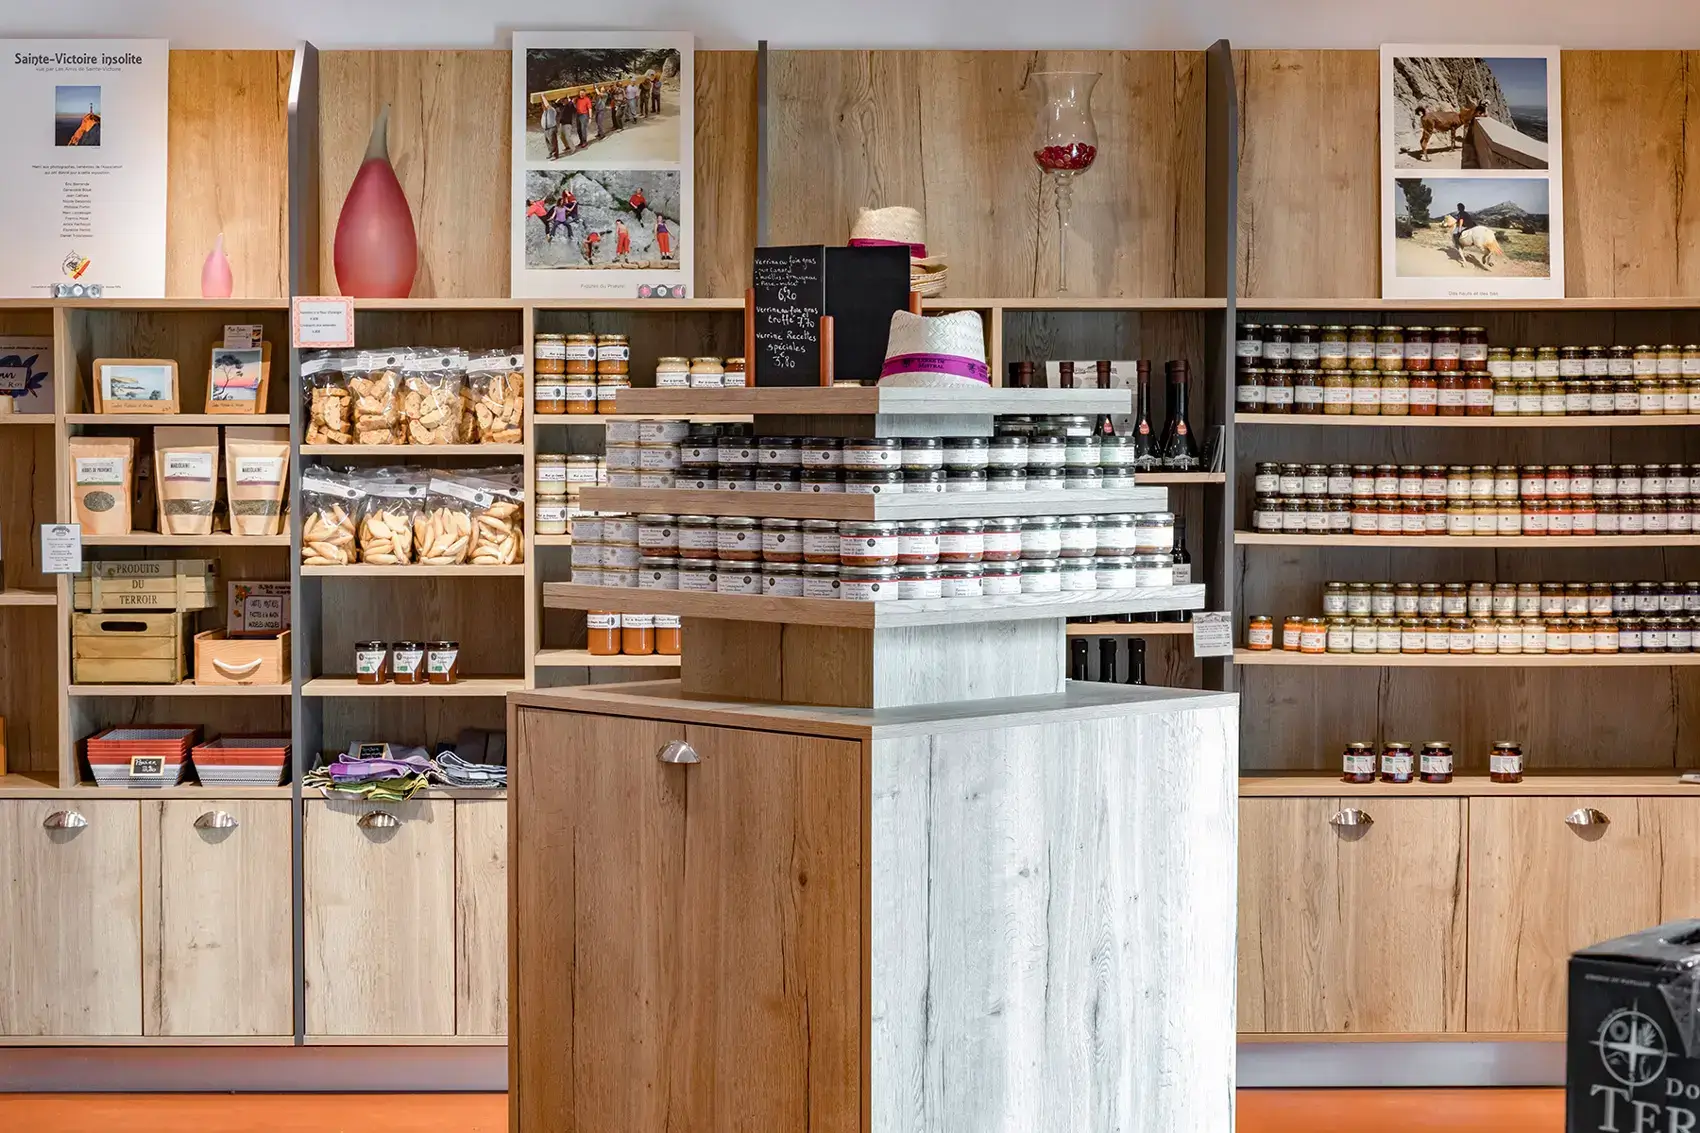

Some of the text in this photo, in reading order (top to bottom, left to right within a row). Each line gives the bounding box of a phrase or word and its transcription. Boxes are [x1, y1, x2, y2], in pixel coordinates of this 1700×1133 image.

[14, 52, 143, 66] Sainte-Victoire insolite
[116, 564, 160, 574] PRODUITS
[132, 580, 144, 589] DU
[119, 595, 158, 605] TERROIR
